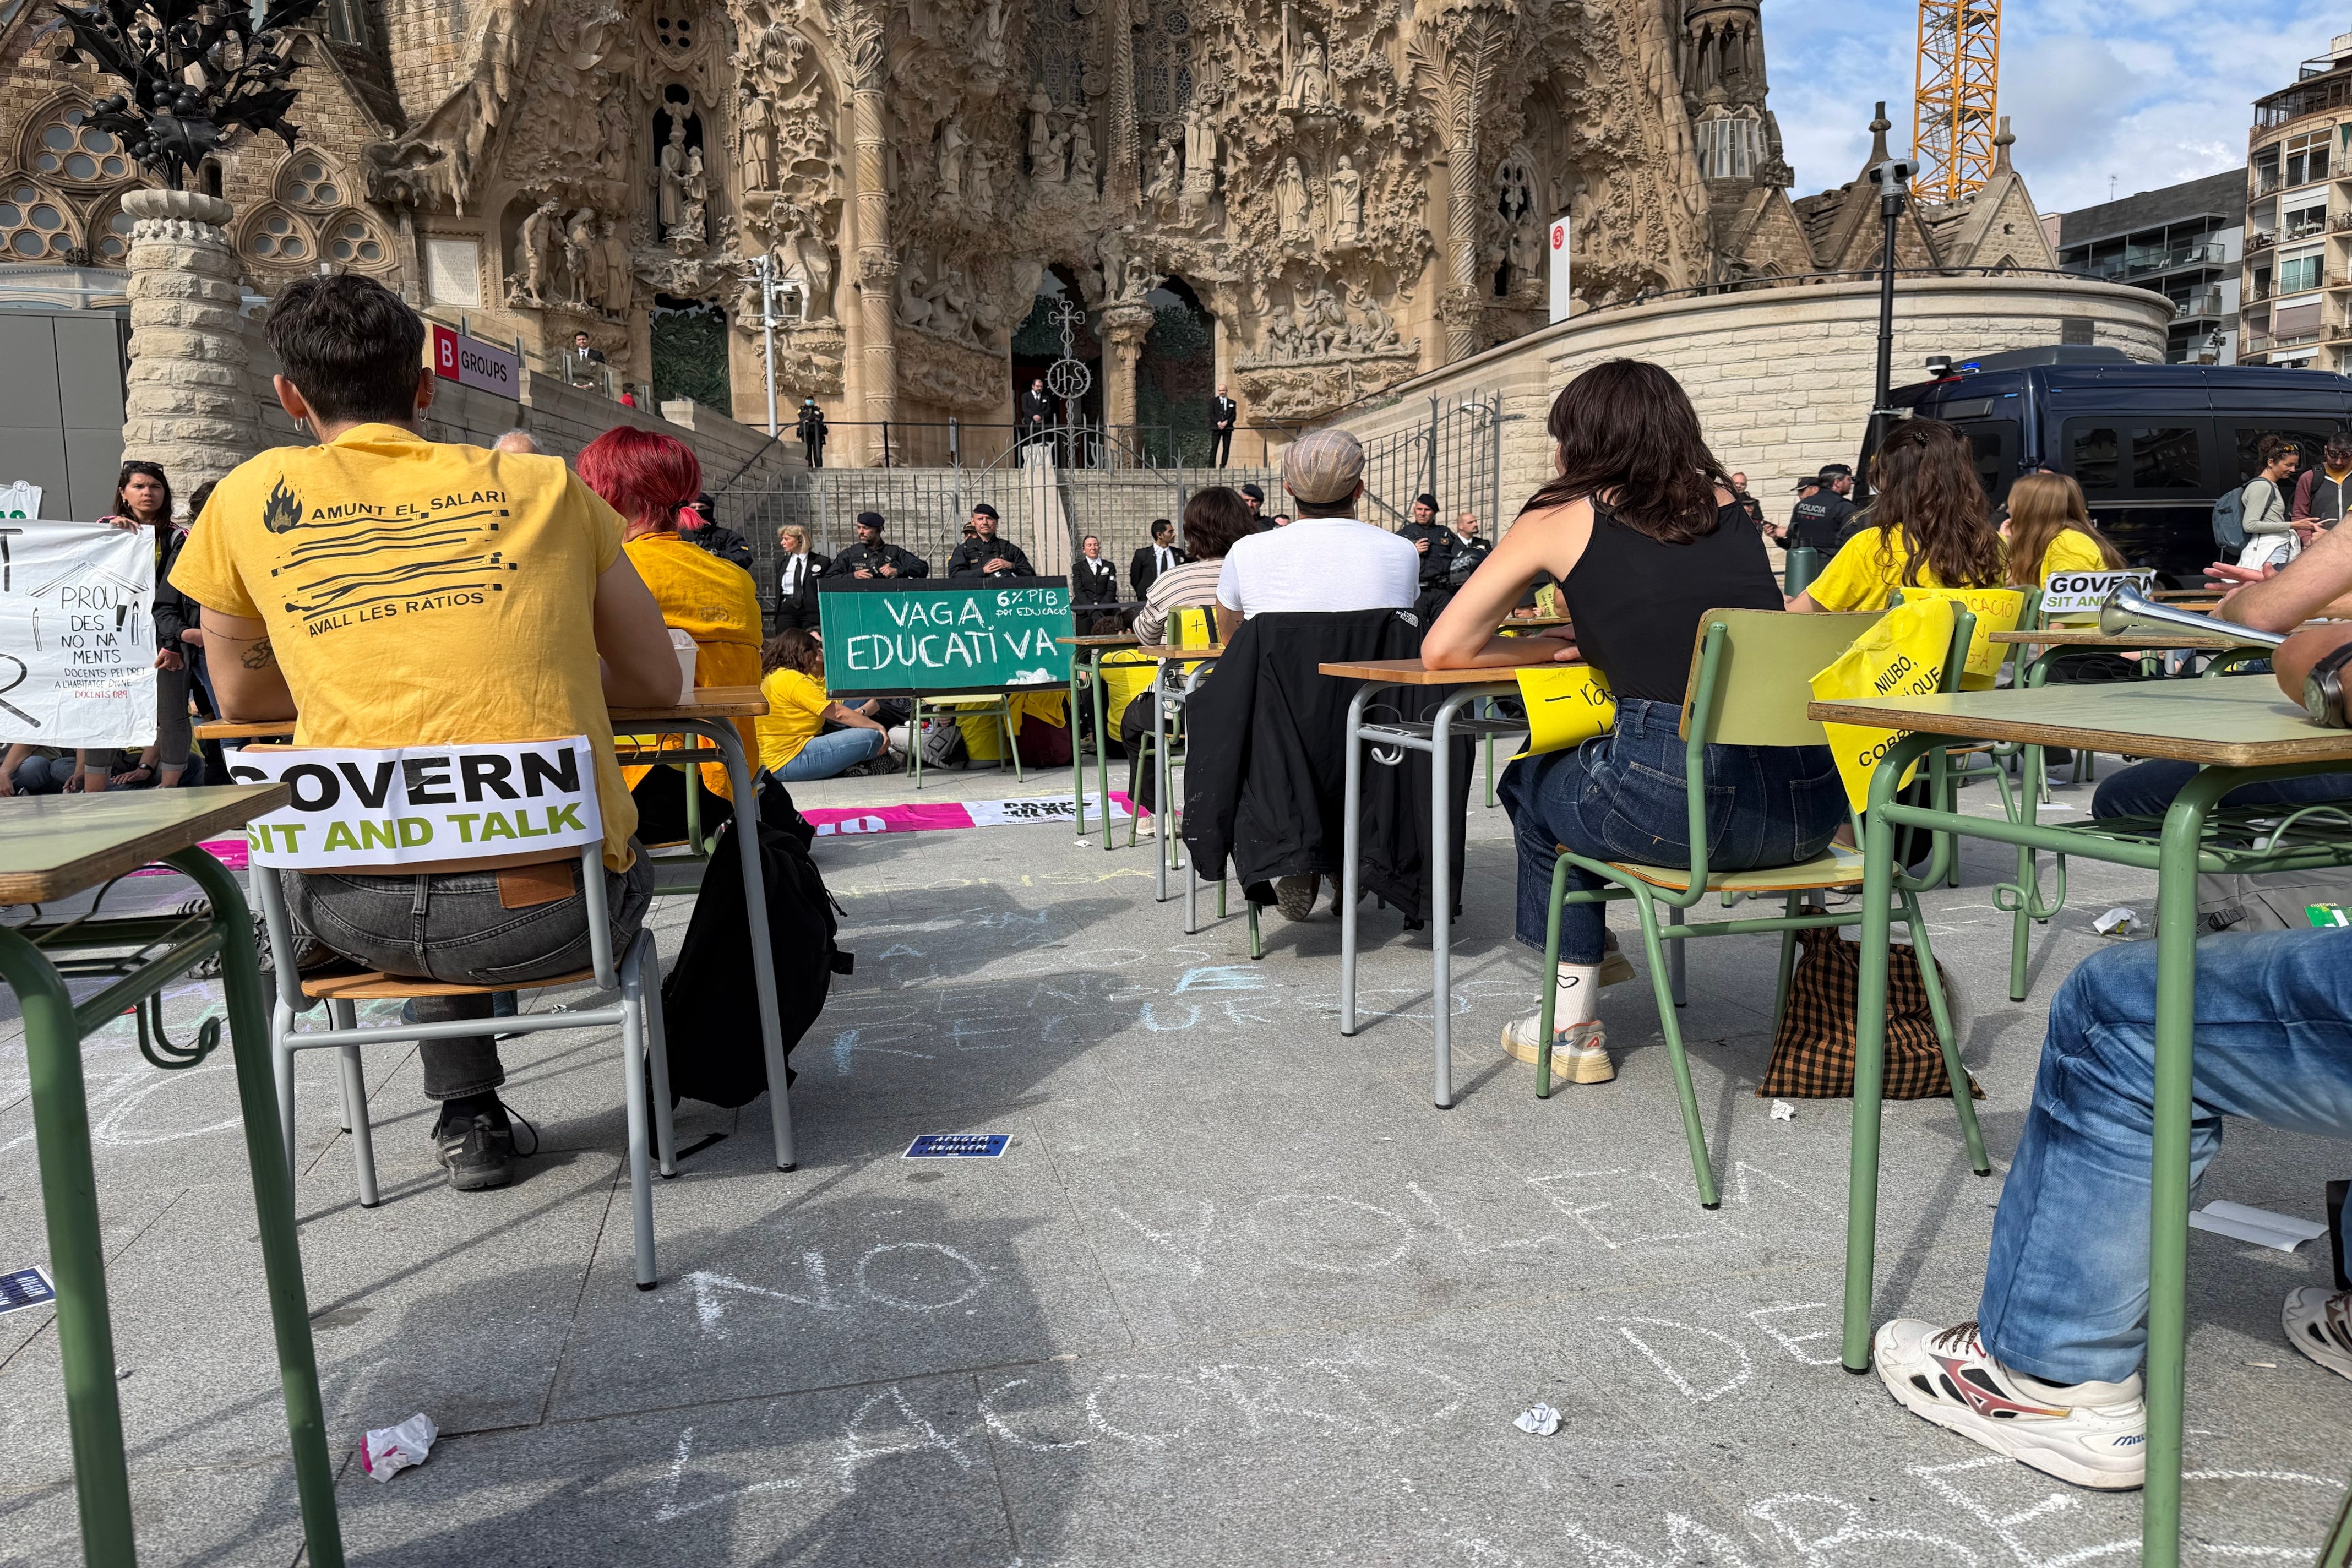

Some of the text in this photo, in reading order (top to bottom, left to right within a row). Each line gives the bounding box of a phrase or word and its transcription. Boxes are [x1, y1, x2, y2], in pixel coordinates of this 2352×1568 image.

[440, 338, 508, 382] B GROUPS
[312, 490, 507, 520] AMUNT EL SALARI
[1798, 503, 1826, 514] POLICIA
[62, 586, 118, 609] PROU
[997, 591, 1023, 607] 6%
[2047, 596, 2073, 607] SIT
[308, 591, 484, 638] AVALL LES RÀTIOS
[883, 597, 984, 628] VAGA
[1016, 605, 1069, 616] EDUCACIÓ
[71, 615, 104, 631] DES
[62, 632, 118, 648] NO NA
[73, 649, 121, 665] MENTS
[64, 667, 146, 678] DOCENTS PEL DRET
[1874, 654, 1918, 696] NIUBÓ,
[1912, 666, 1940, 695] QUE
[108, 679, 132, 688] DIGNE
[113, 690, 128, 699] 089
[246, 801, 586, 853] SIT AND TALK
[682, 1241, 988, 1324] NO
[1596, 1302, 1842, 1403] DE
